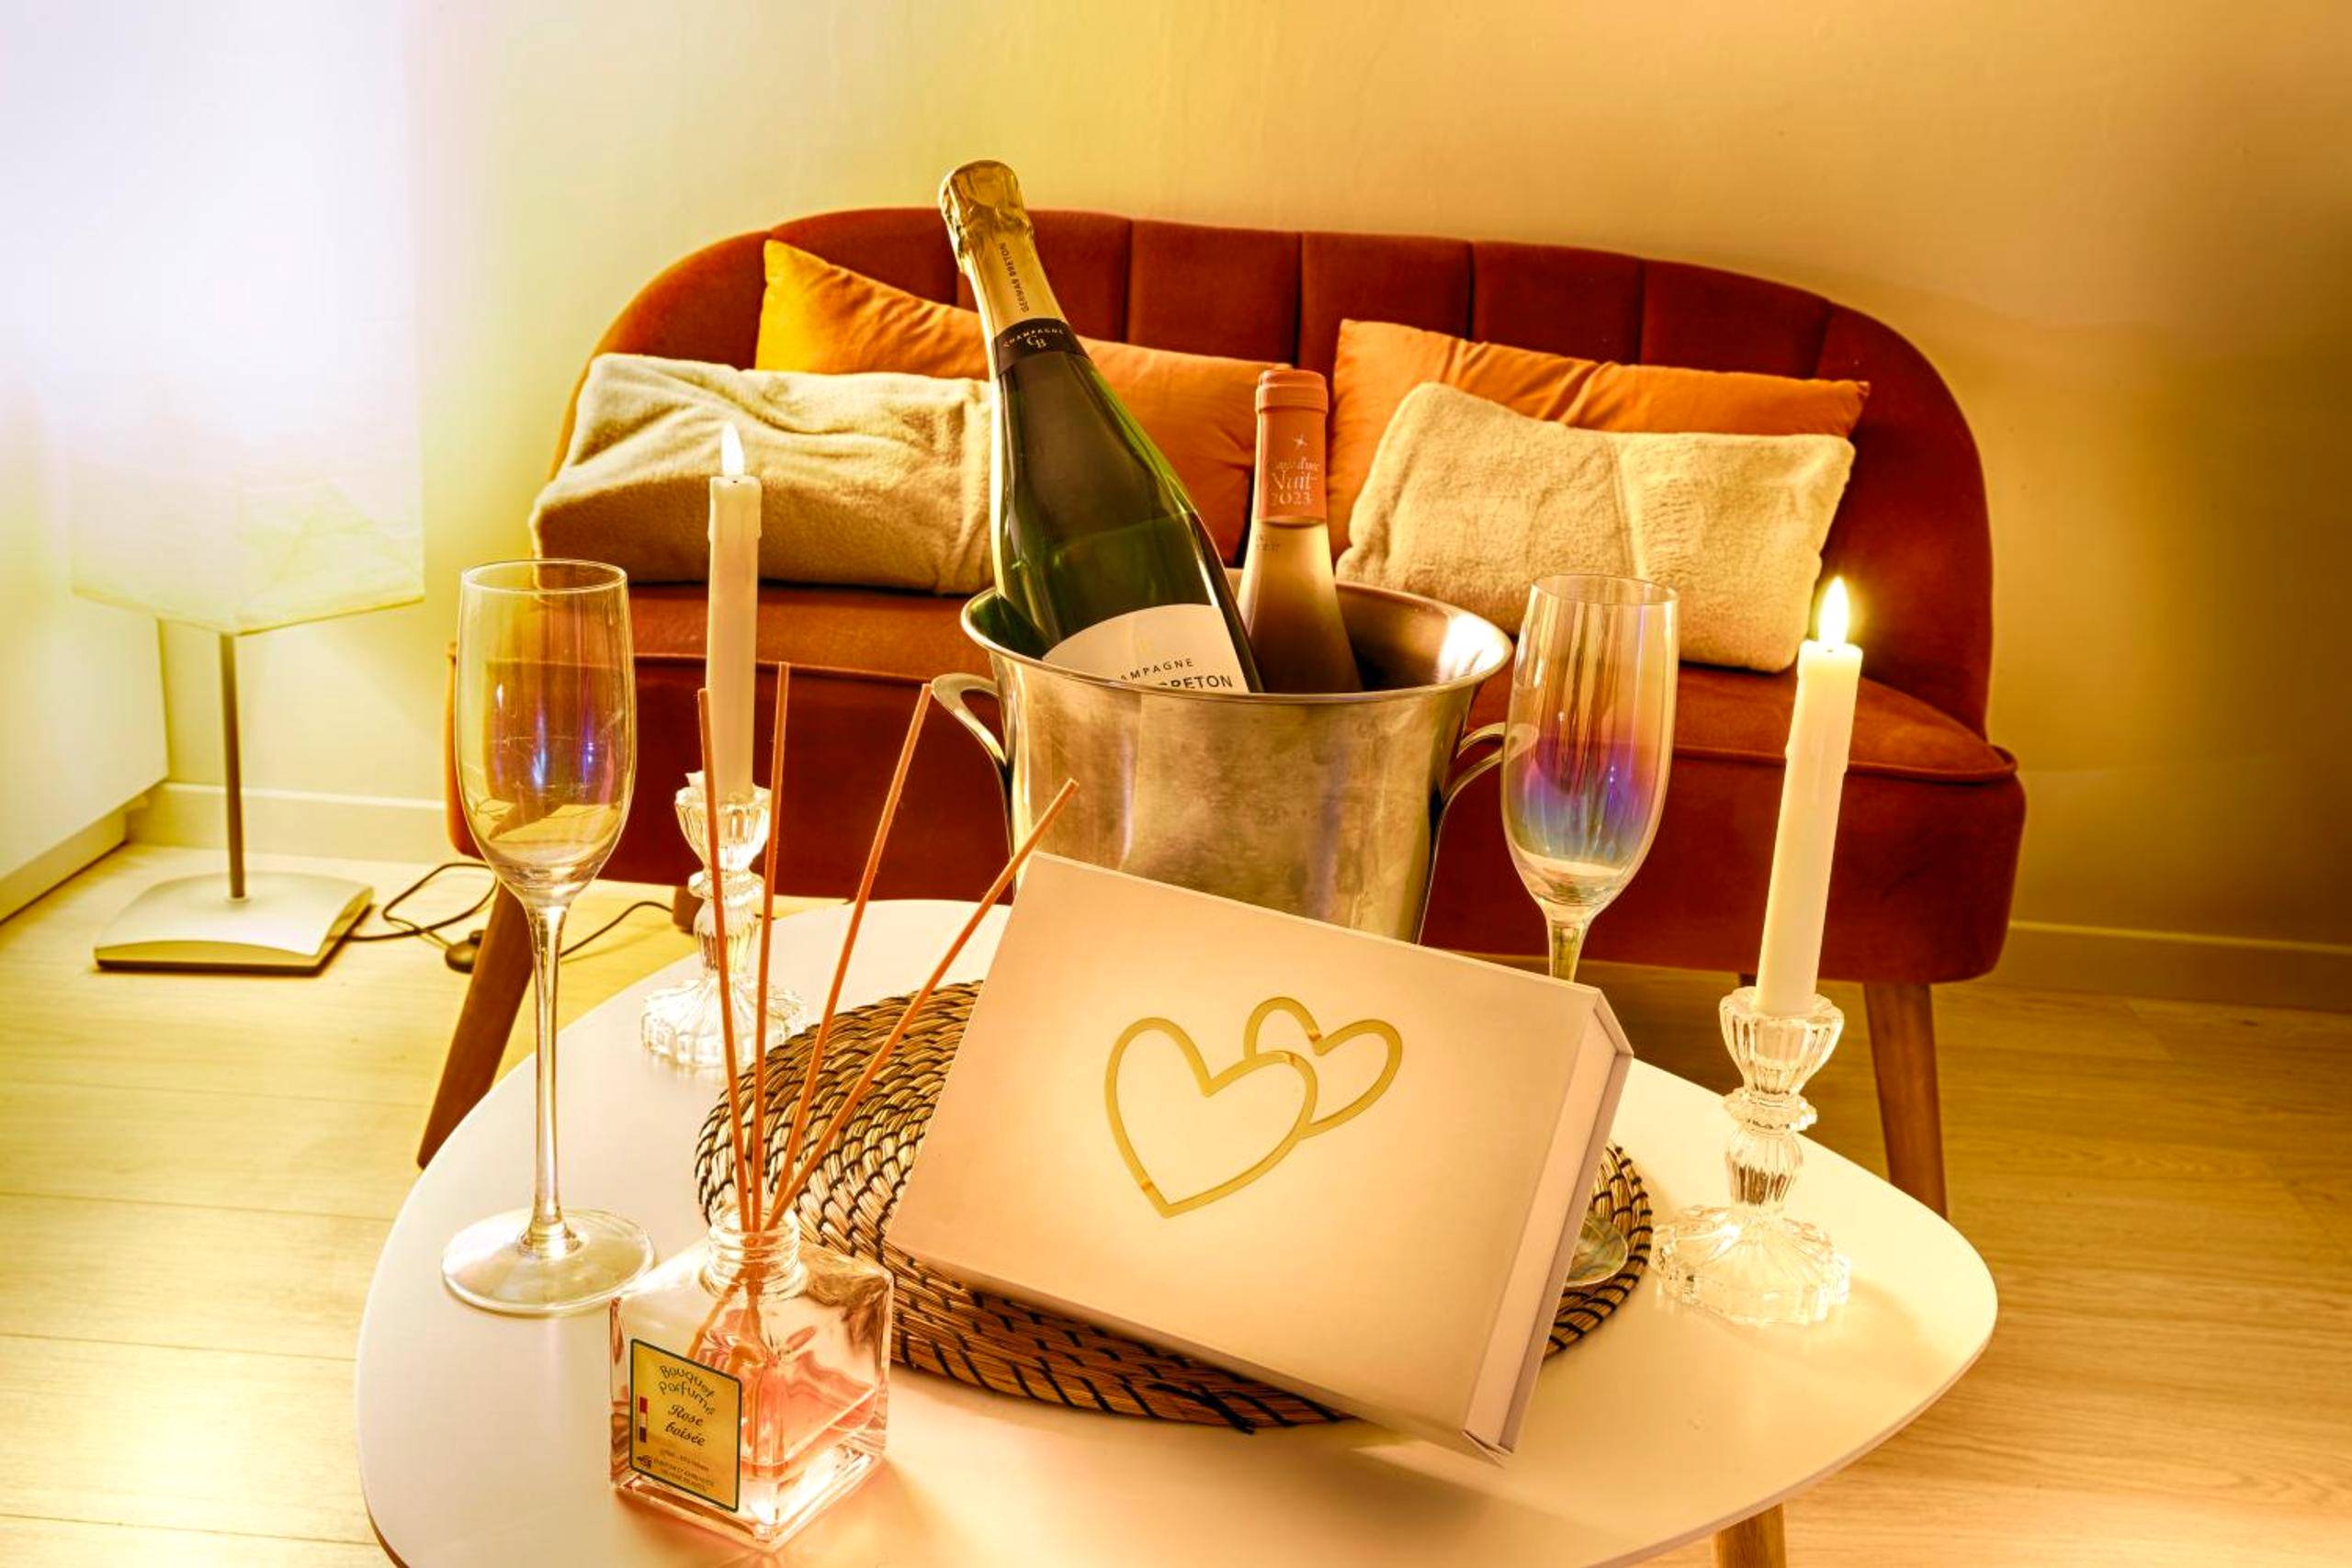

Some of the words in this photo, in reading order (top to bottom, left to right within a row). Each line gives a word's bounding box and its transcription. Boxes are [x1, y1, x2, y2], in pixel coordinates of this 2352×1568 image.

[999, 243, 1016, 276] BRETON
[1002, 328, 1064, 347] CHAMPAGNE
[1159, 675, 1233, 688] RETON
[667, 1404, 704, 1427] Rose
